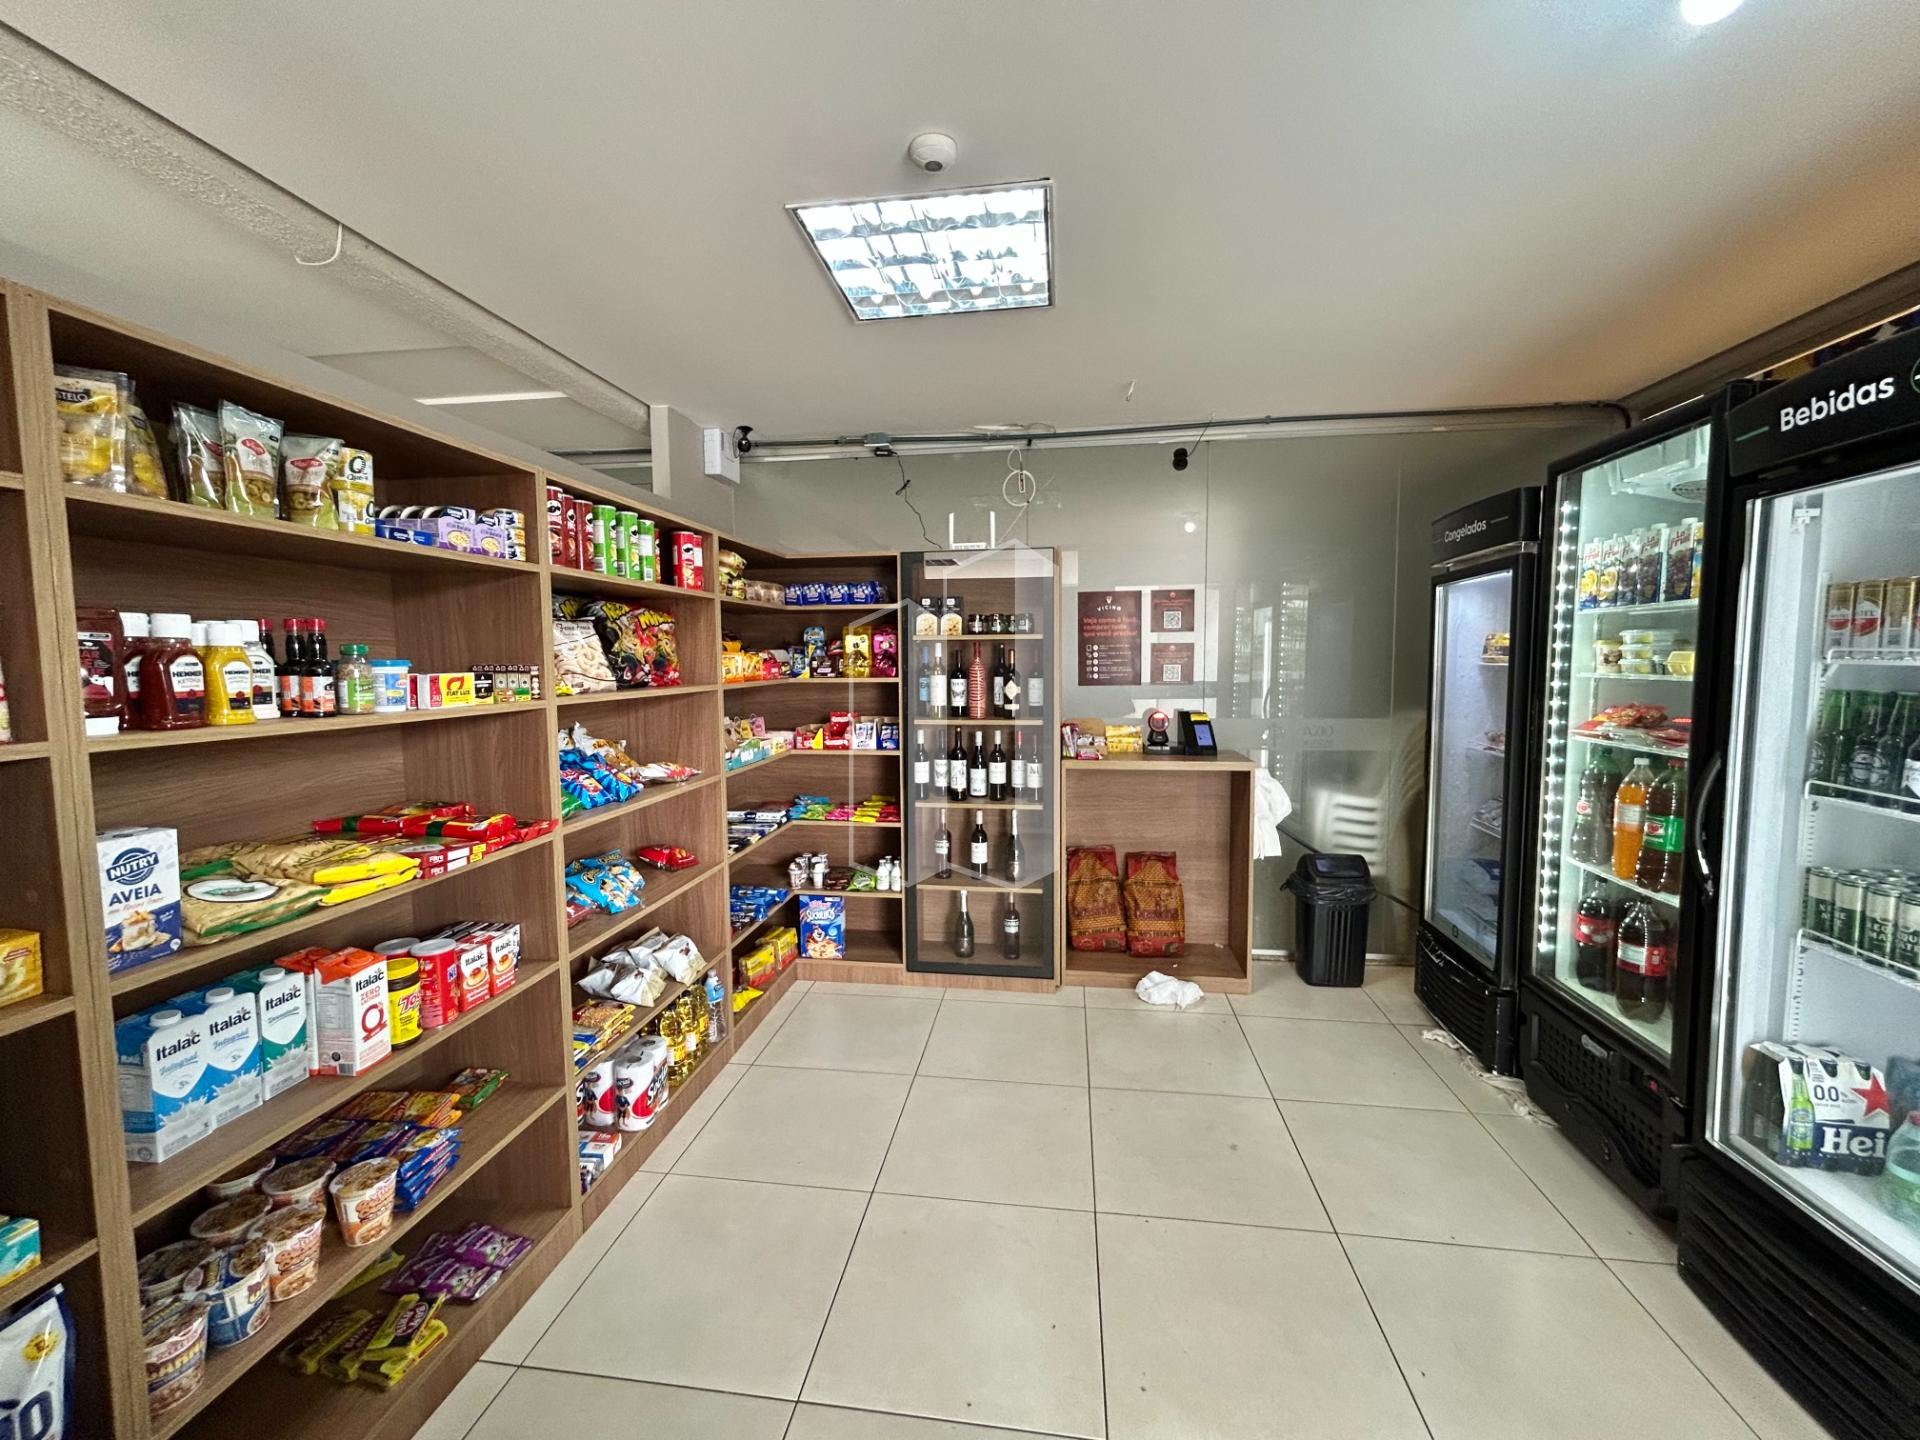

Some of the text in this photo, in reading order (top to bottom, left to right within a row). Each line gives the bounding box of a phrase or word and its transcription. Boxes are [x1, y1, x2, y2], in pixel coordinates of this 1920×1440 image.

[1780, 377, 1895, 432] Bebidas
[1444, 519, 1487, 542] Congelados
[110, 853, 158, 881] NUTRY
[109, 883, 162, 907] AVEIA
[465, 953, 485, 967] Italac
[355, 972, 385, 993] Italac
[265, 988, 301, 1012] Italac
[209, 1008, 252, 1037] Italac
[156, 1033, 201, 1062] Italac
[1814, 1084, 1840, 1102] 0.0
